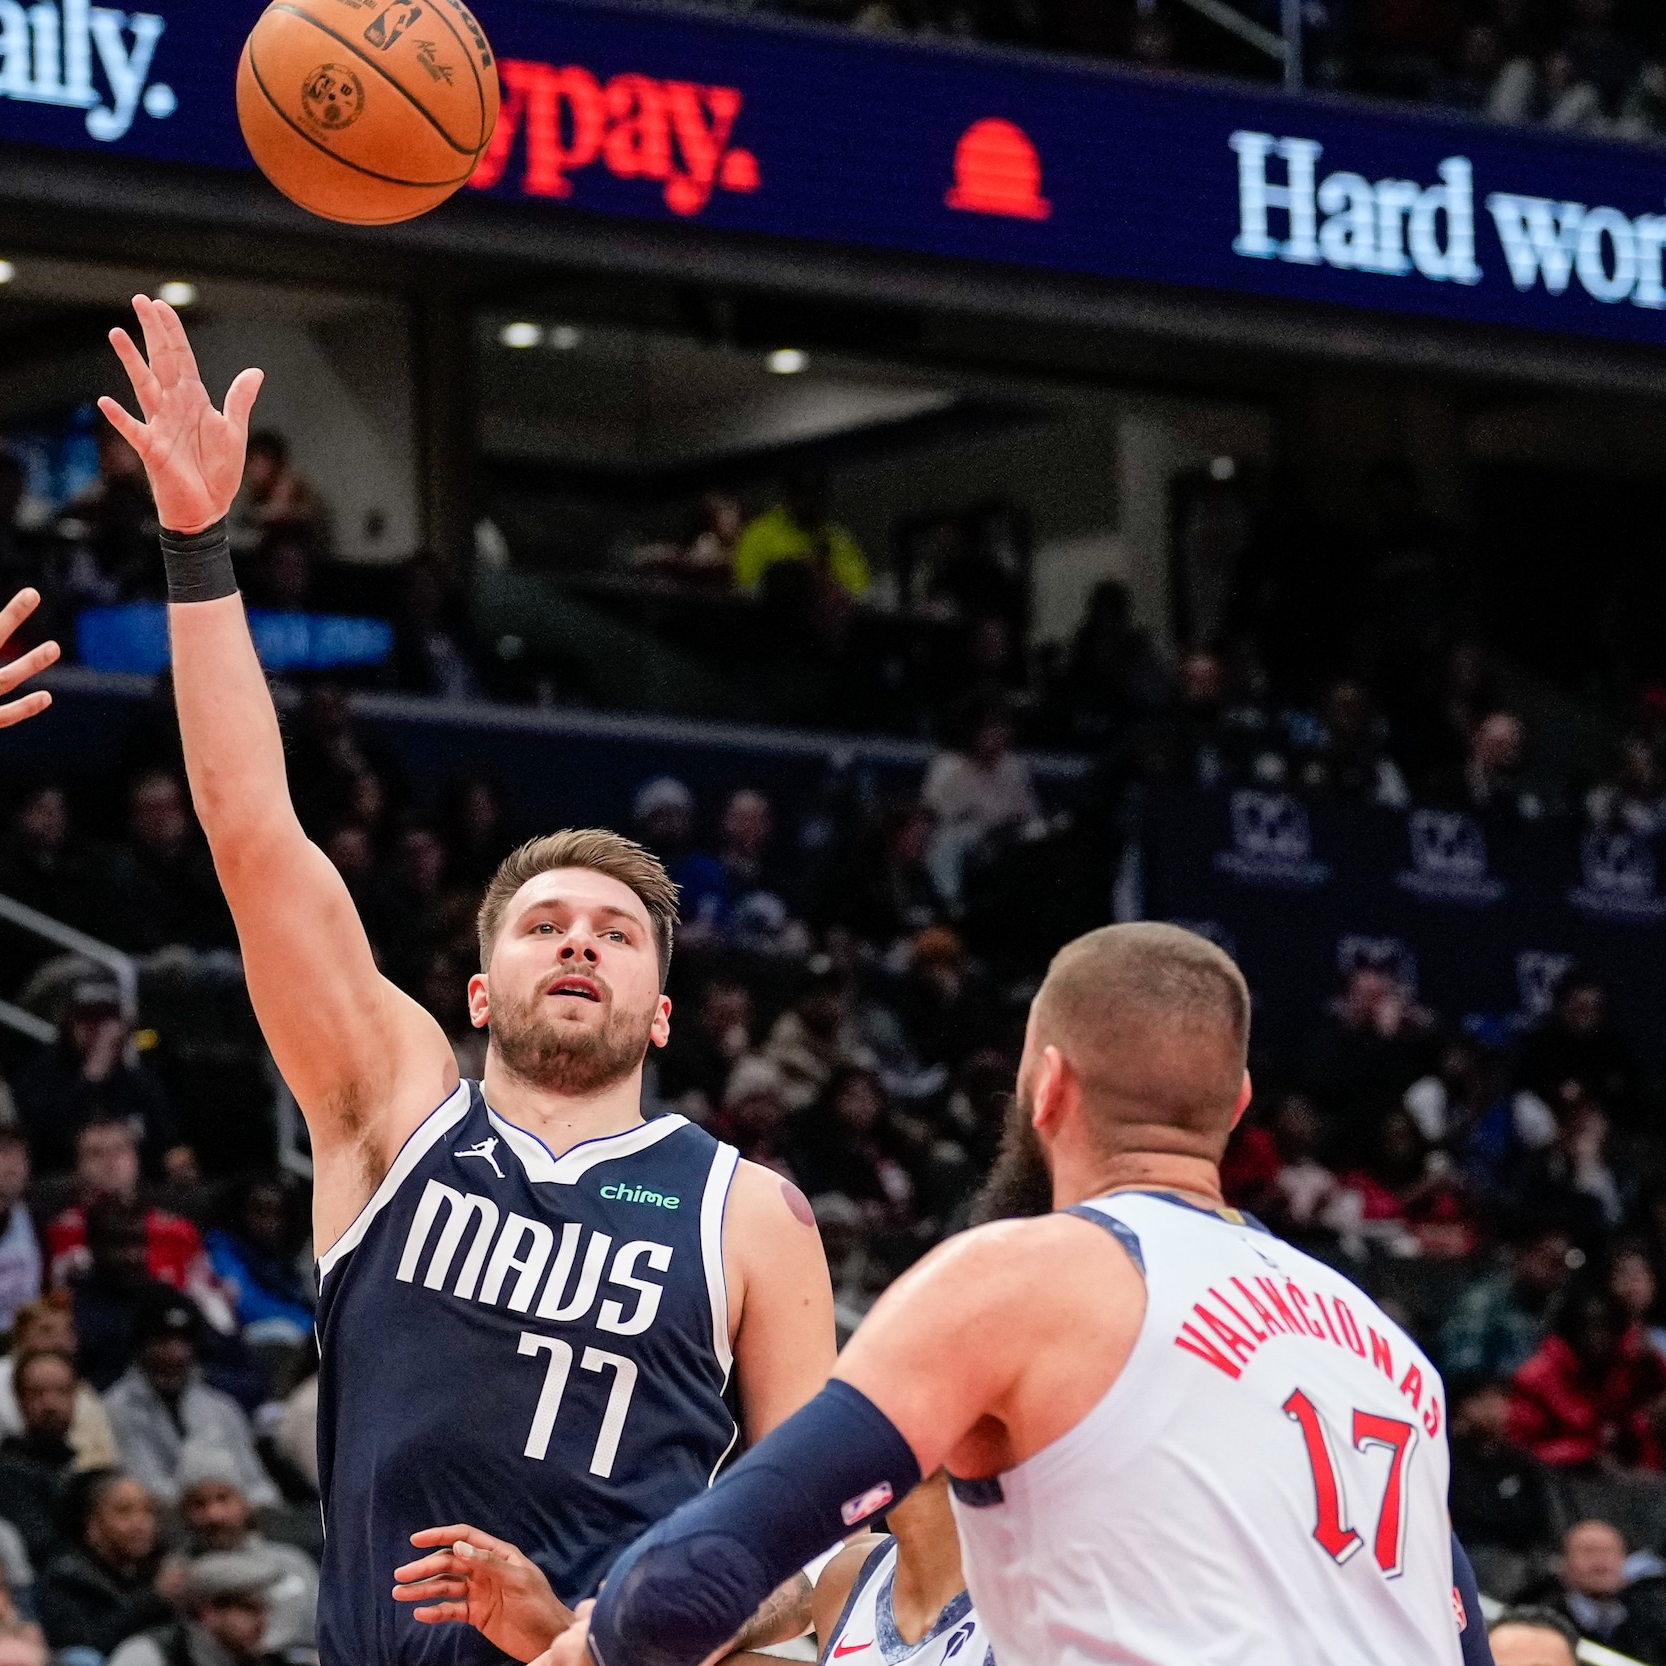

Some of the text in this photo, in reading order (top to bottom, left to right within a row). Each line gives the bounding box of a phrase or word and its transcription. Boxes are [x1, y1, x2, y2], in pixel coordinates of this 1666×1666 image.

[467, 57, 761, 216] ypay.
[1229, 129, 1483, 286] Hard
[395, 1178, 674, 1336] MAVS
[600, 1183, 680, 1210] chime
[517, 1331, 638, 1480] 77
[1282, 1387, 1418, 1580] 17
